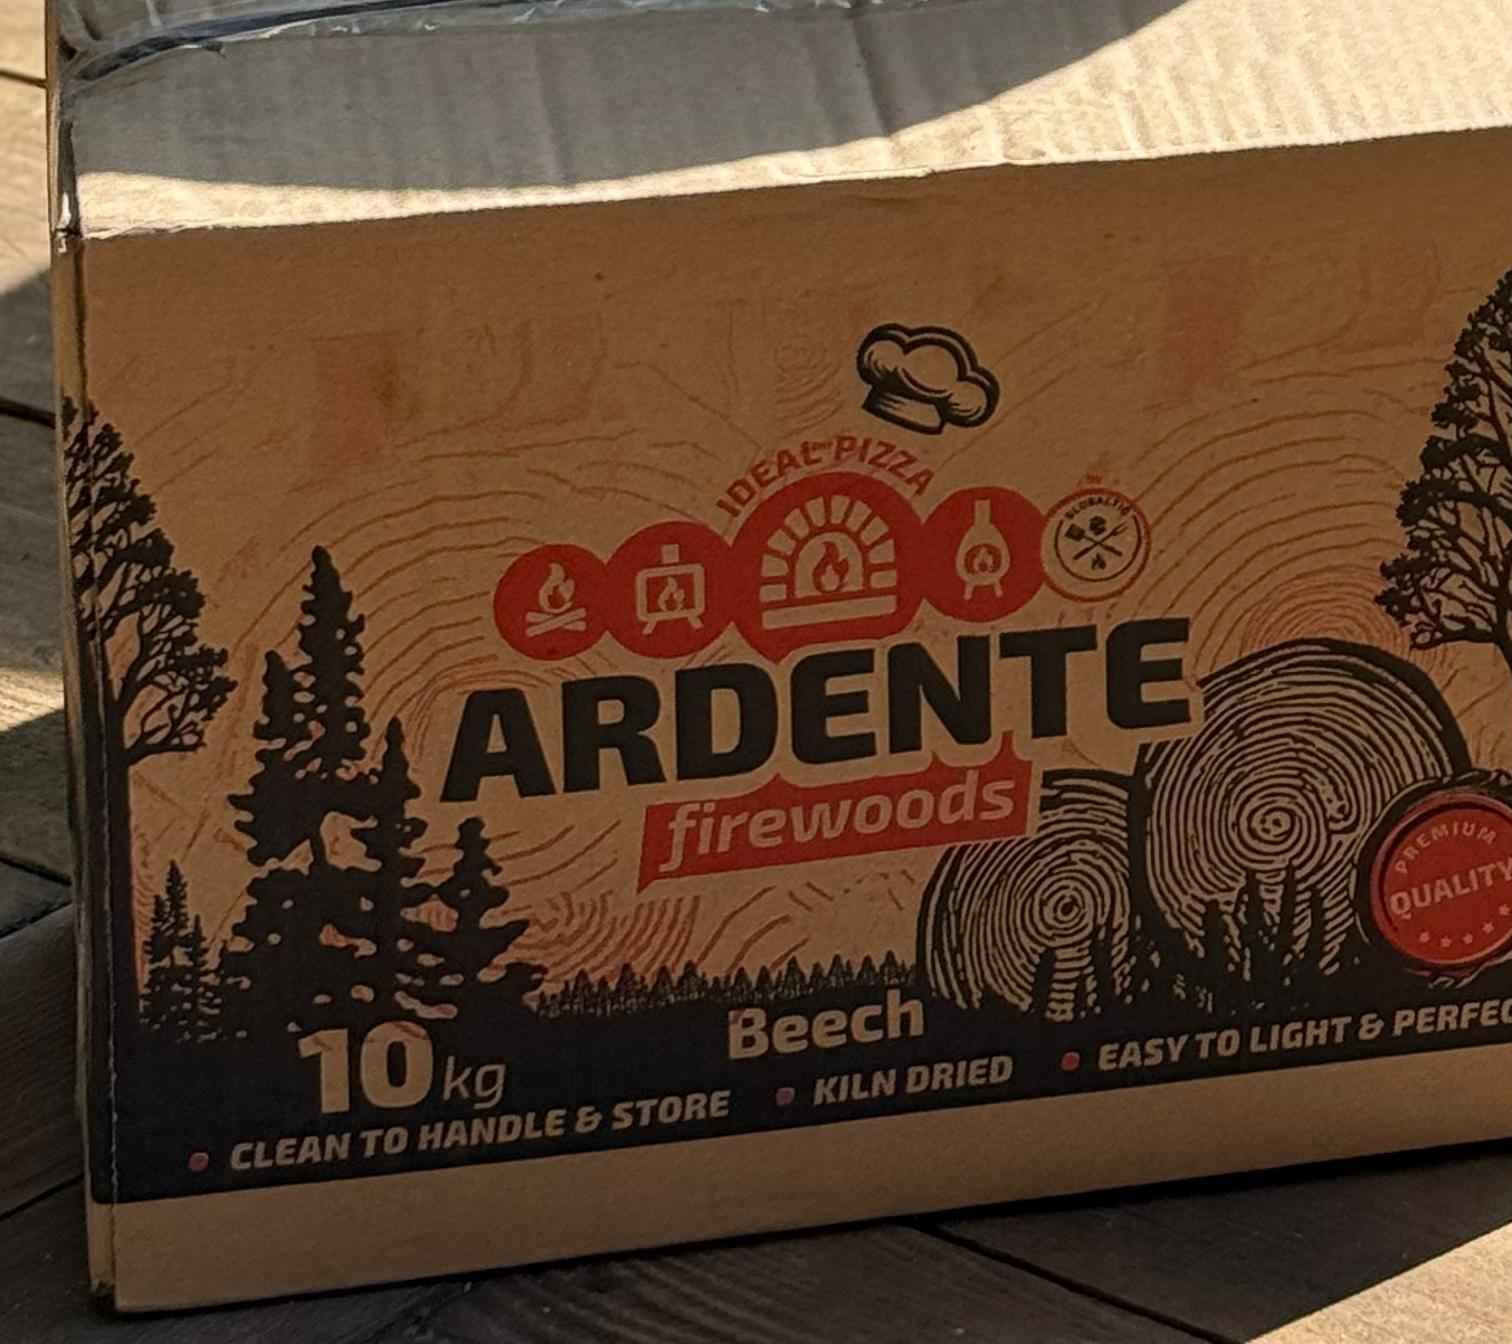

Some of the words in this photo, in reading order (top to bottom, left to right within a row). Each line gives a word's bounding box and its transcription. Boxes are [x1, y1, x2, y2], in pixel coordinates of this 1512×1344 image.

[716, 441, 823, 518] IDEAL
[834, 435, 935, 496] PIZZA
[440, 618, 1192, 803] ARDENTE
[658, 769, 1015, 873] firewoods
[1395, 821, 1496, 874] PREMIUM
[727, 988, 926, 1060] Beech
[1098, 1034, 1189, 1071] EASY
[1198, 1029, 1241, 1059] TO
[1250, 1016, 1349, 1054] LIGHT
[1358, 1012, 1385, 1041] &
[298, 1021, 434, 1113] 10
[443, 1056, 506, 1110] kg
[813, 1068, 897, 1105] KILN
[905, 1055, 1014, 1095] DRIED
[229, 1133, 351, 1171] CLEAN
[360, 1126, 409, 1159] TO
[417, 1108, 567, 1151] HANDLE
[575, 1105, 603, 1133] &
[612, 1089, 731, 1130] STORE
